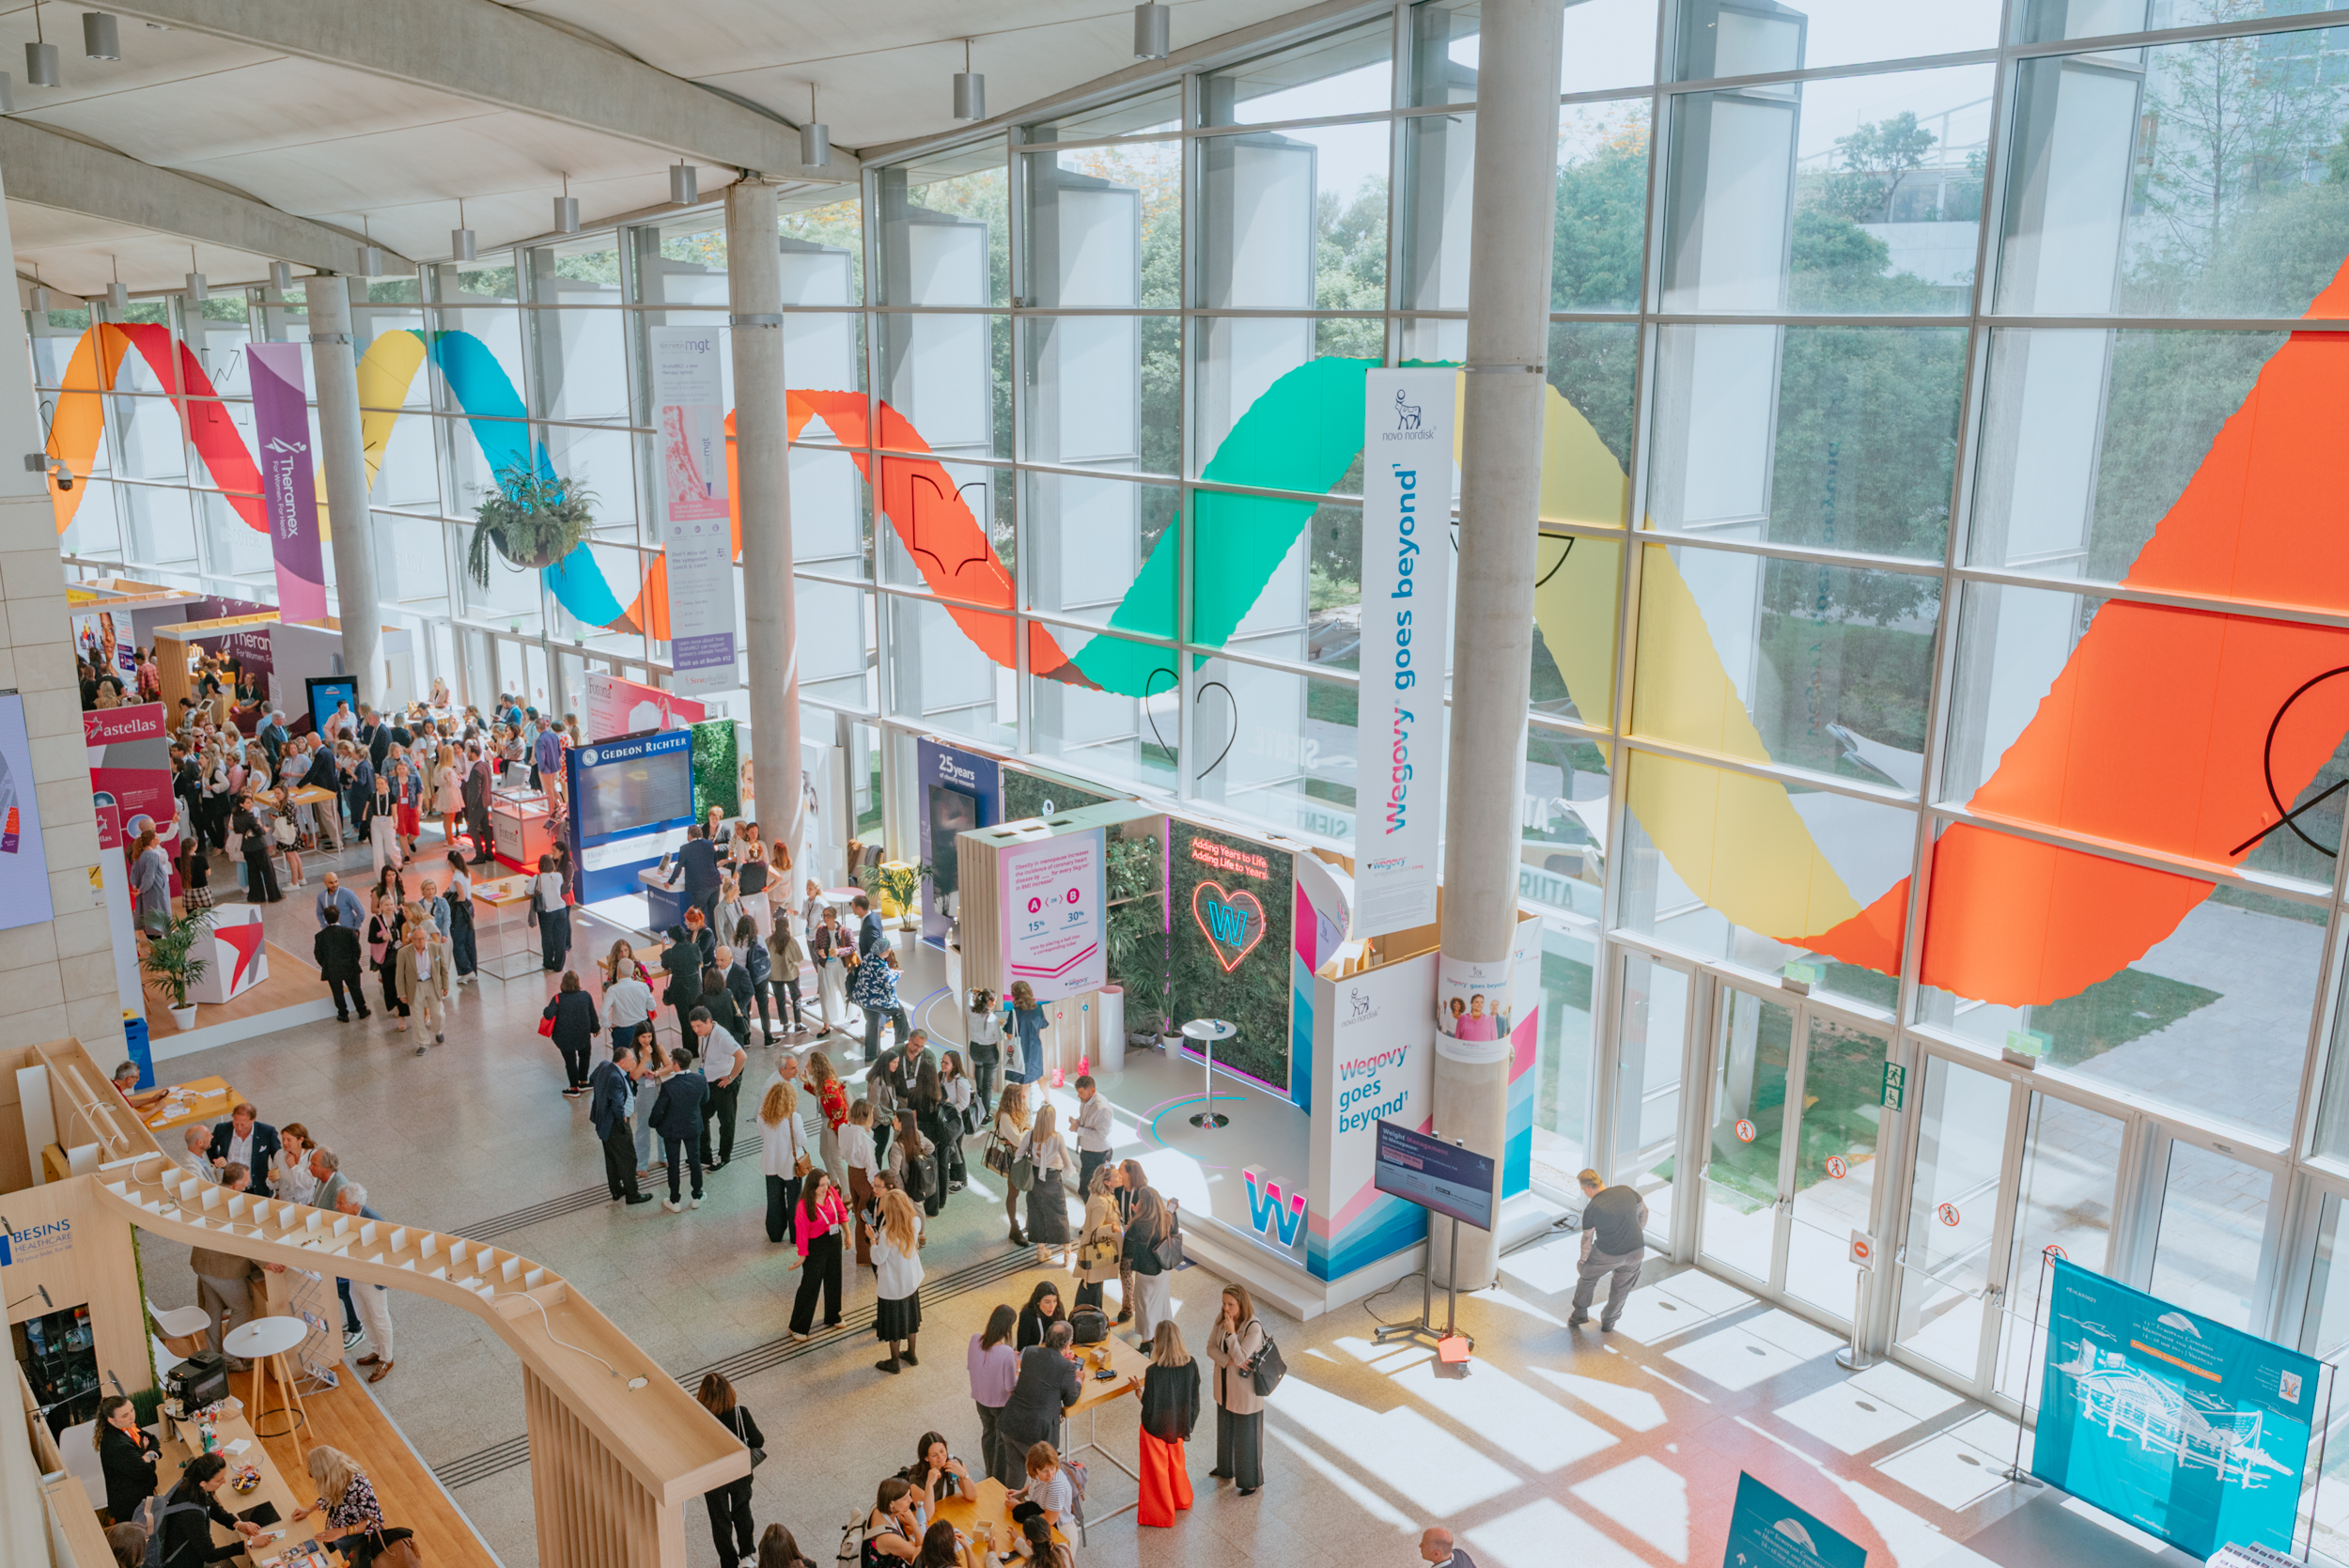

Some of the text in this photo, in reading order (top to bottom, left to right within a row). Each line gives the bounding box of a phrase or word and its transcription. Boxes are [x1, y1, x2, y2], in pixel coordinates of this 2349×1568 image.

[1383, 429, 1434, 441] novo nordisk
[281, 456, 298, 538] Theramex
[237, 648, 245, 657] For
[1394, 610, 1416, 691] goes
[588, 677, 611, 699] Fotona
[103, 720, 157, 737] astellas
[940, 753, 975, 781] 25 years
[944, 774, 958, 784] obesity
[958, 778, 975, 789] research
[499, 824, 518, 843] Fotona
[587, 847, 610, 860] Health
[619, 845, 632, 853] our
[633, 838, 660, 850] mission
[1040, 855, 1066, 864] menopause
[1192, 838, 1268, 868] Adding Years to Life
[1024, 866, 1047, 875] incidence
[1053, 861, 1074, 869] coronary
[1192, 849, 1268, 879] Adding Life to Years
[1032, 877, 1054, 887] increase?
[1030, 900, 1039, 911] A
[1069, 891, 1077, 902] B
[1029, 910, 1084, 932] 15% 30%
[1208, 901, 1248, 946] W
[1037, 944, 1066, 955] corresponding
[1342, 1008, 1379, 1028] novo nordisk
[1340, 1045, 1408, 1081] Wegovy
[1340, 1079, 1381, 1112] goes
[1382, 1127, 1449, 1156] Weight Management
[1389, 1137, 1419, 1152] Menopause:
[1383, 1148, 1402, 1158] Thursday
[1242, 1168, 1307, 1249] W
[13, 1219, 70, 1243] BESINS
[15, 1233, 72, 1252] HEALTHCARE
[2132, 1340, 2163, 1358] Empowering
[2163, 1354, 2182, 1365] Science
[2192, 1366, 2219, 1381] Healthcare
[2283, 1373, 2300, 1383] EMAS
